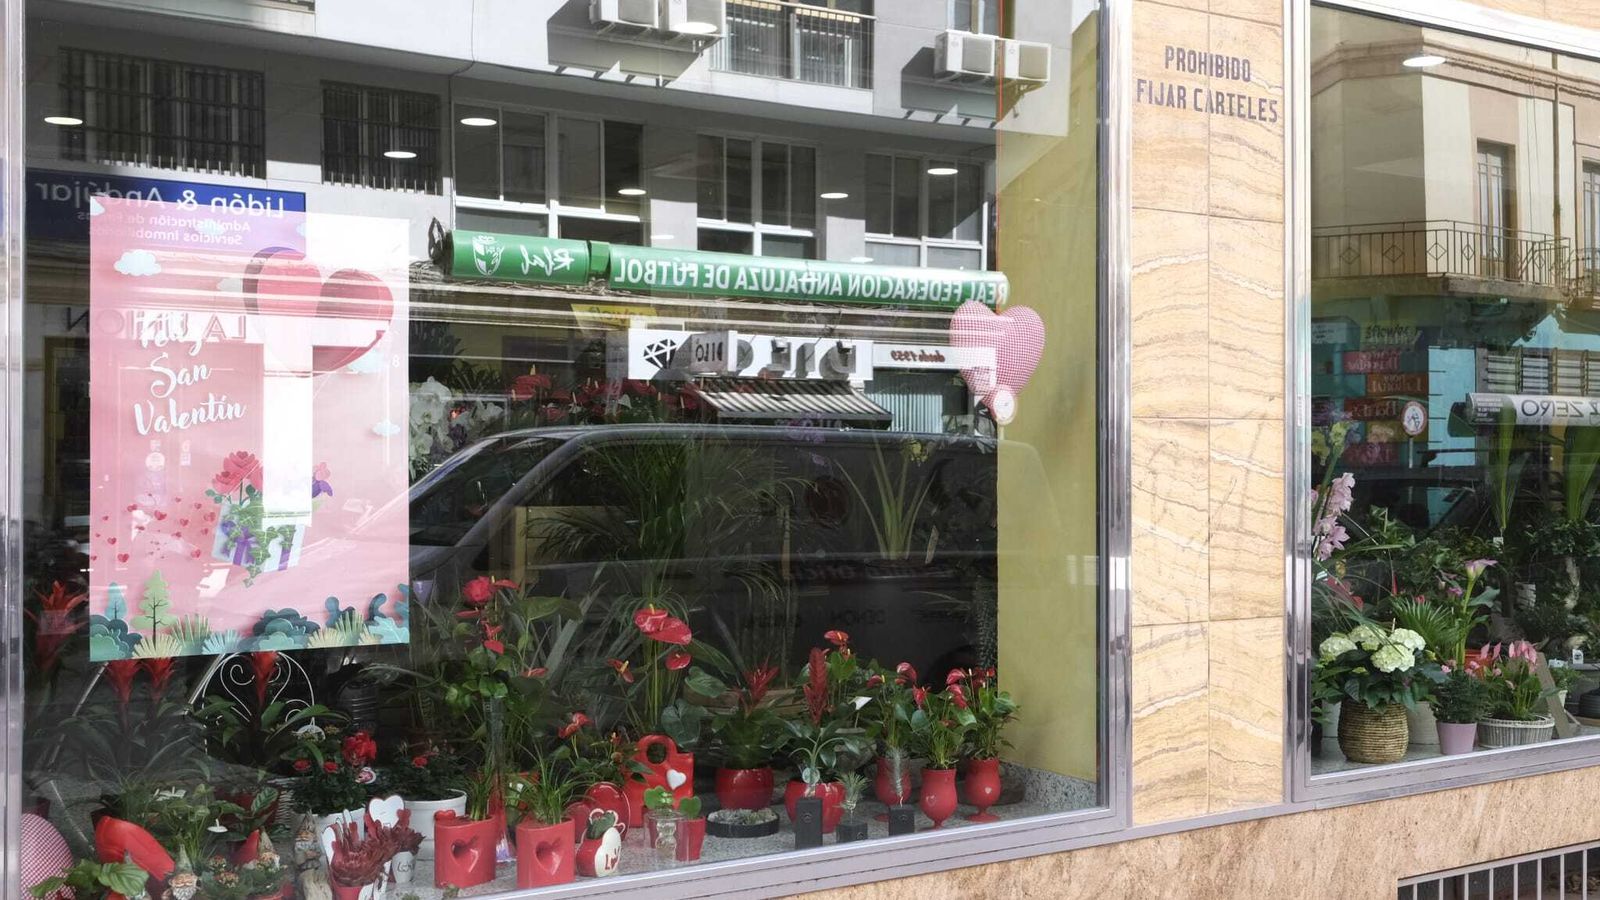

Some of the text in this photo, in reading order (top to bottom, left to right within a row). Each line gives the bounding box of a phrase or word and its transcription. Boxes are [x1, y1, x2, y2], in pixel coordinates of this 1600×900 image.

[1165, 45, 1250, 82] PROHIBIDO
[1136, 79, 1278, 123] FIJAR CARTELES
[150, 352, 213, 398] San
[134, 393, 247, 436] Valentín
